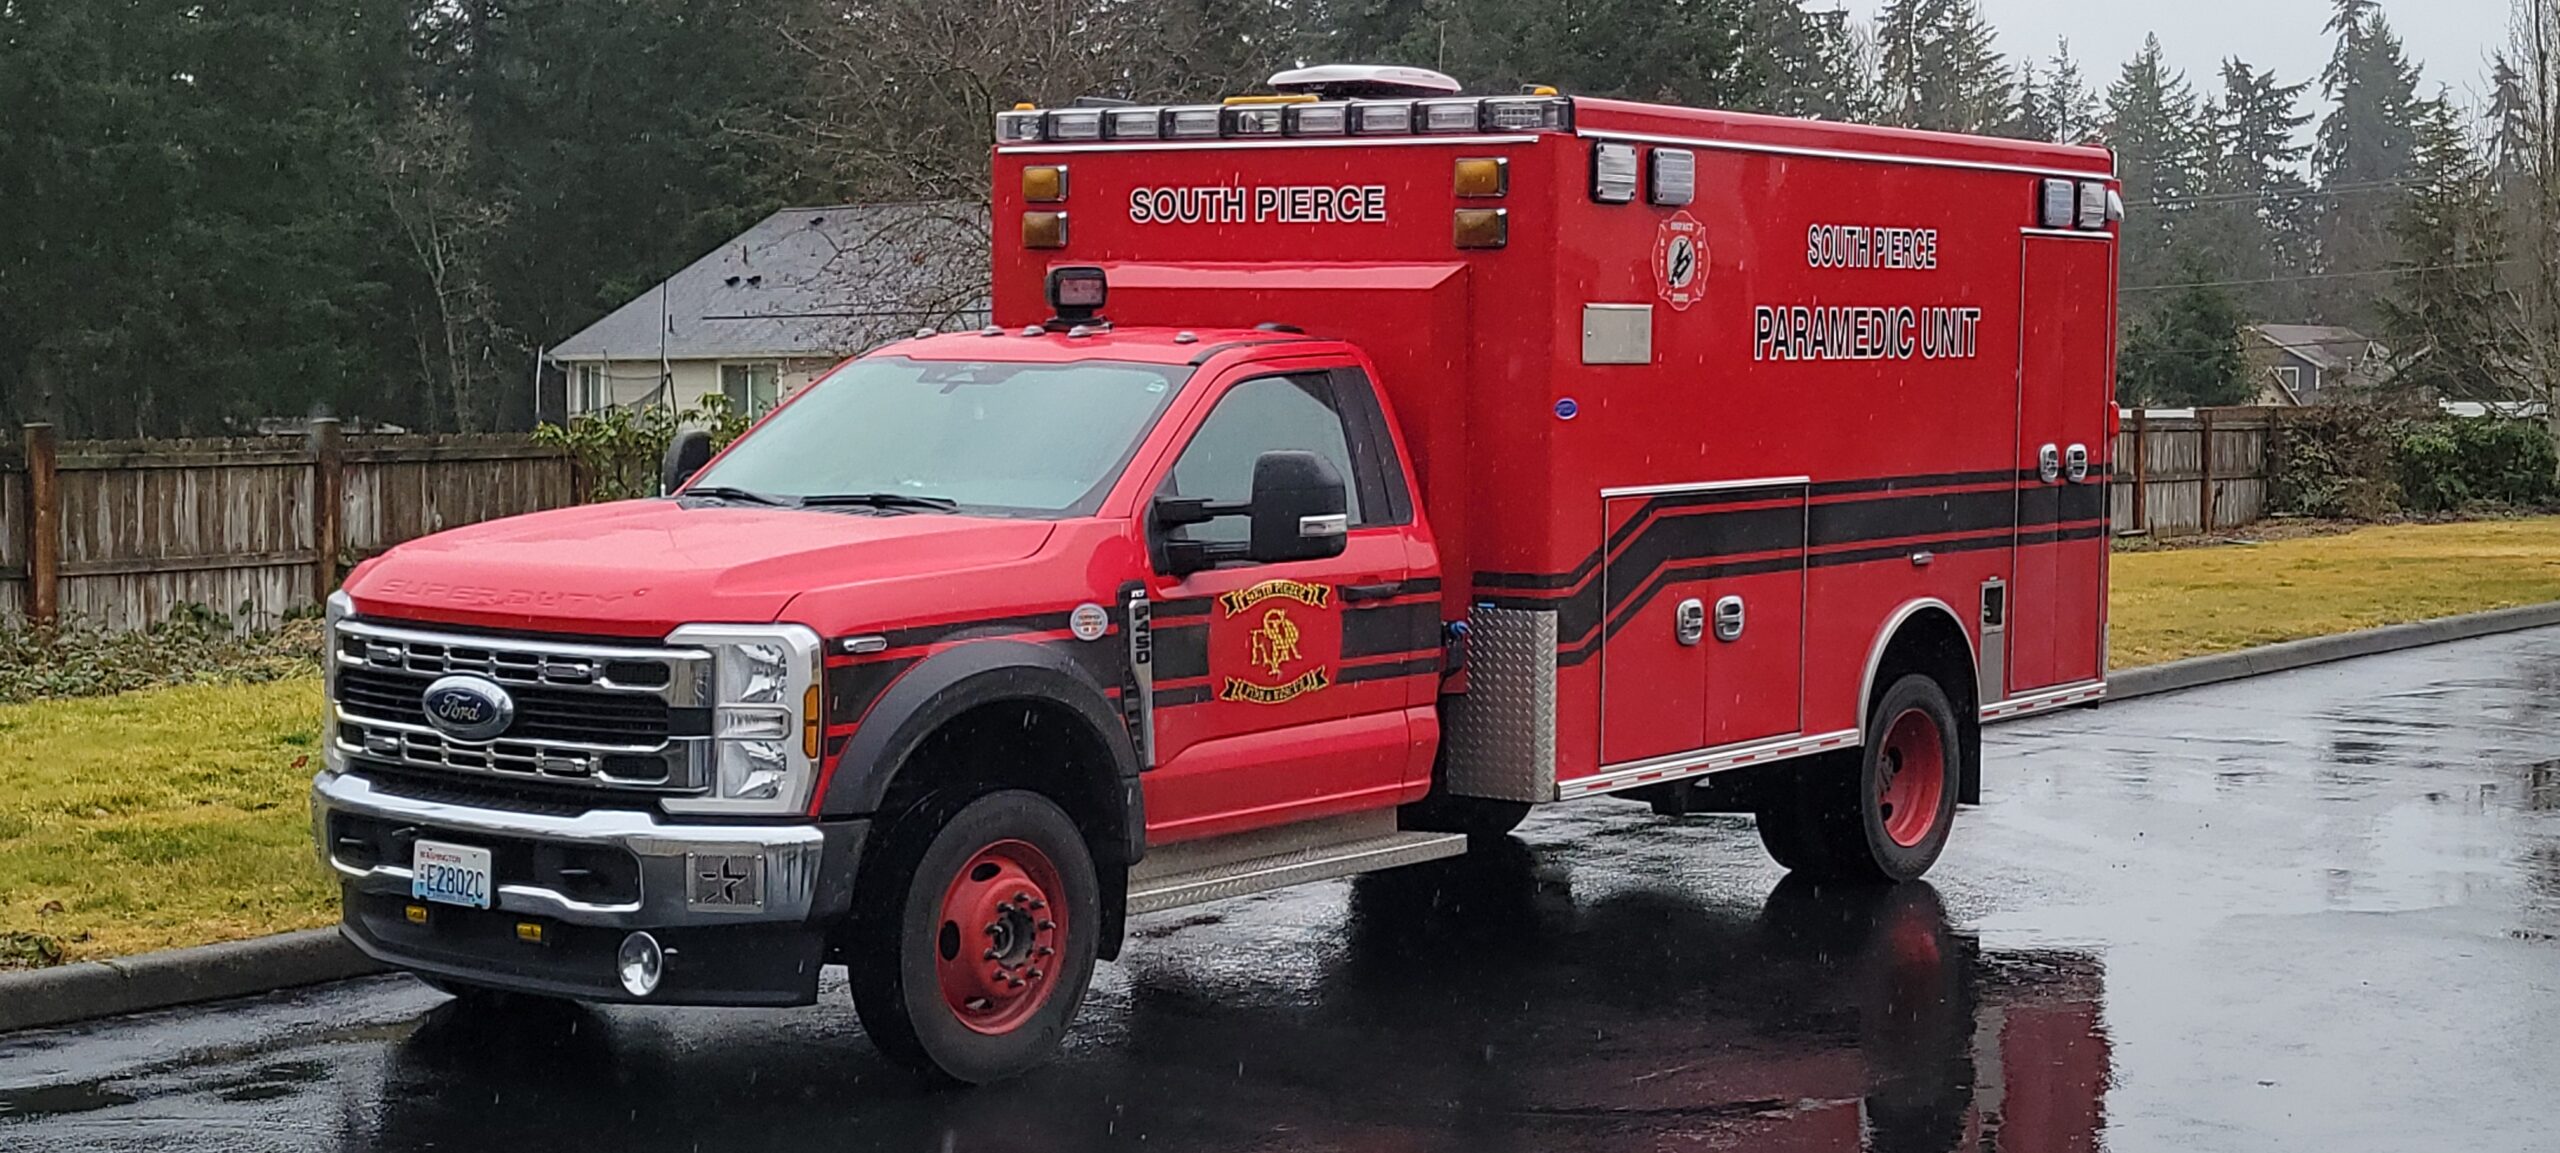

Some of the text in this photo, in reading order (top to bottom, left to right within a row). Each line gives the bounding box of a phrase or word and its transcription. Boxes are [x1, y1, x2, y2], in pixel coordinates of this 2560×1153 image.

[1130, 185, 1386, 223] SOUTH PIERCE
[1808, 224, 1937, 269] SOUTH PIERCE
[1754, 305, 1981, 361] PARAMEDIC UNIT
[379, 579, 626, 606] SUPER DUTY
[1134, 604, 1151, 665] F450
[439, 692, 482, 721] Ford
[427, 863, 484, 900] E2802C
